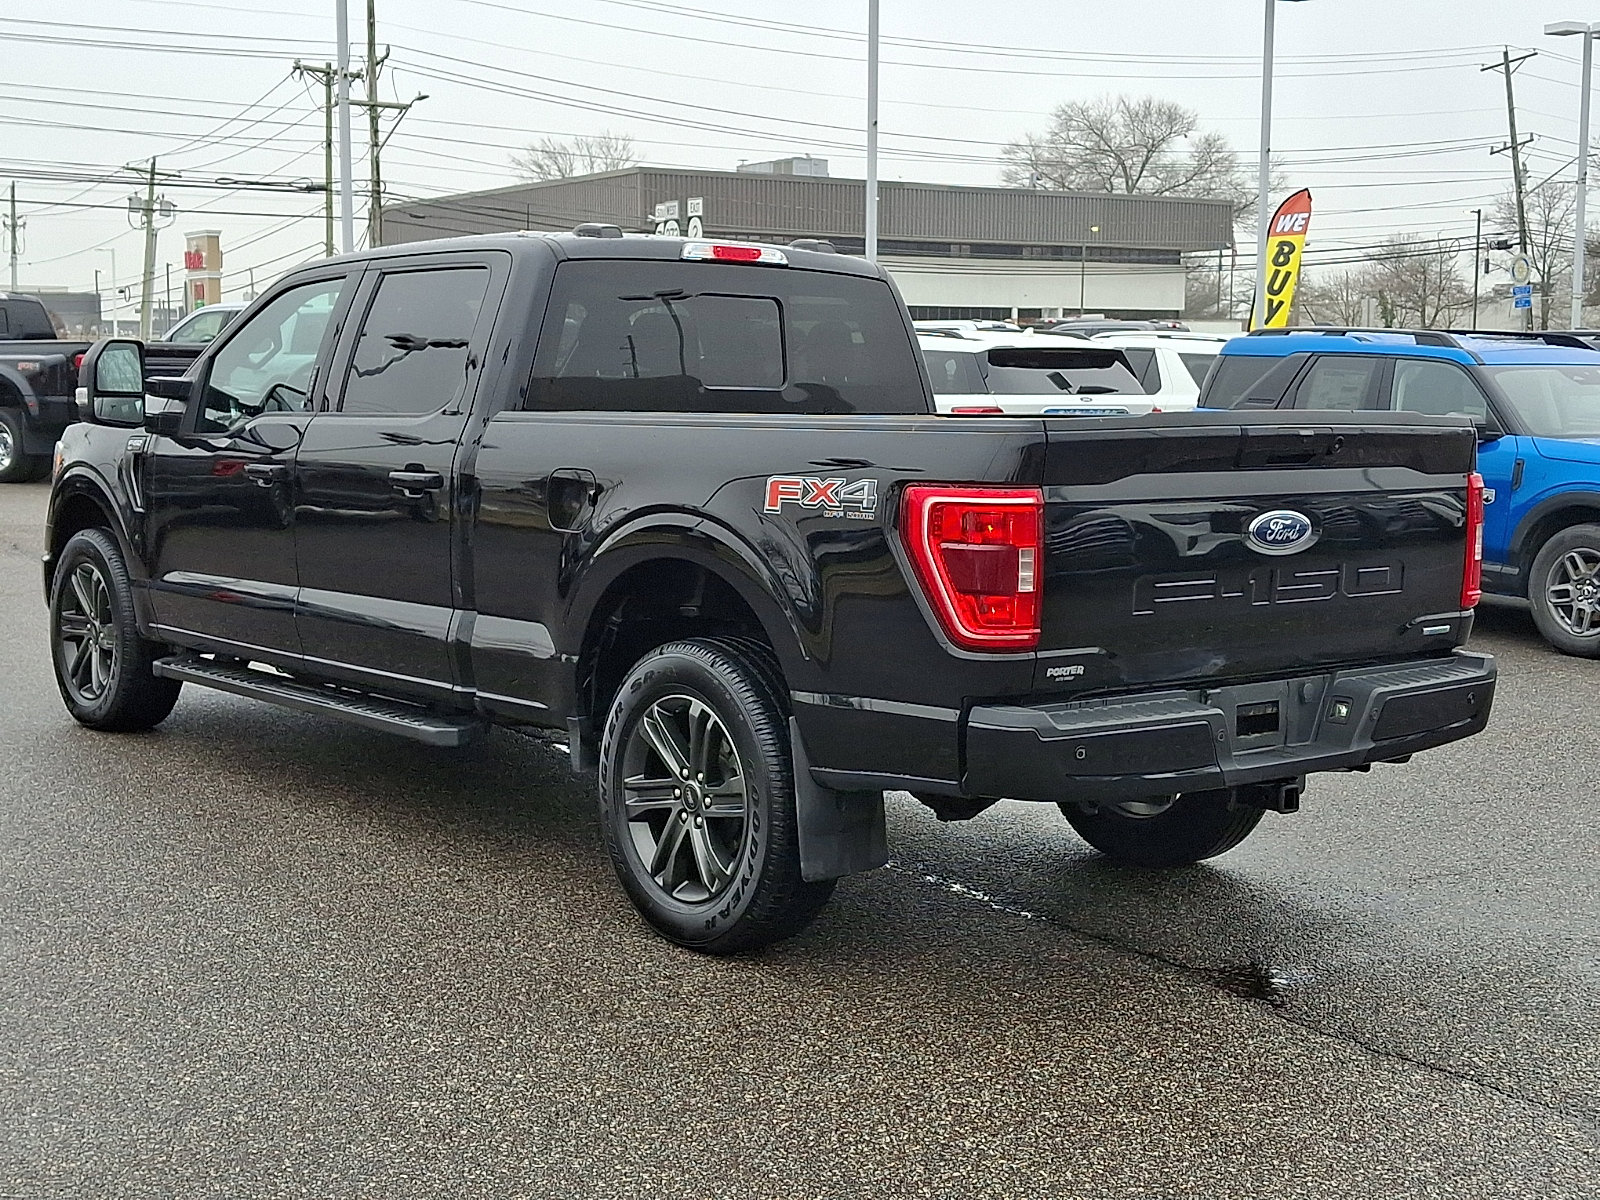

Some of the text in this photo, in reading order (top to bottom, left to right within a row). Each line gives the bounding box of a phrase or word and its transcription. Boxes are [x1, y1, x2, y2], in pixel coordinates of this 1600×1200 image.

[1275, 212, 1310, 233] WE
[1264, 240, 1296, 326] BUY
[763, 475, 878, 514] FX4
[1266, 518, 1300, 542] Ford
[1132, 559, 1404, 616] F-150
[1046, 665, 1085, 677] PORTER
